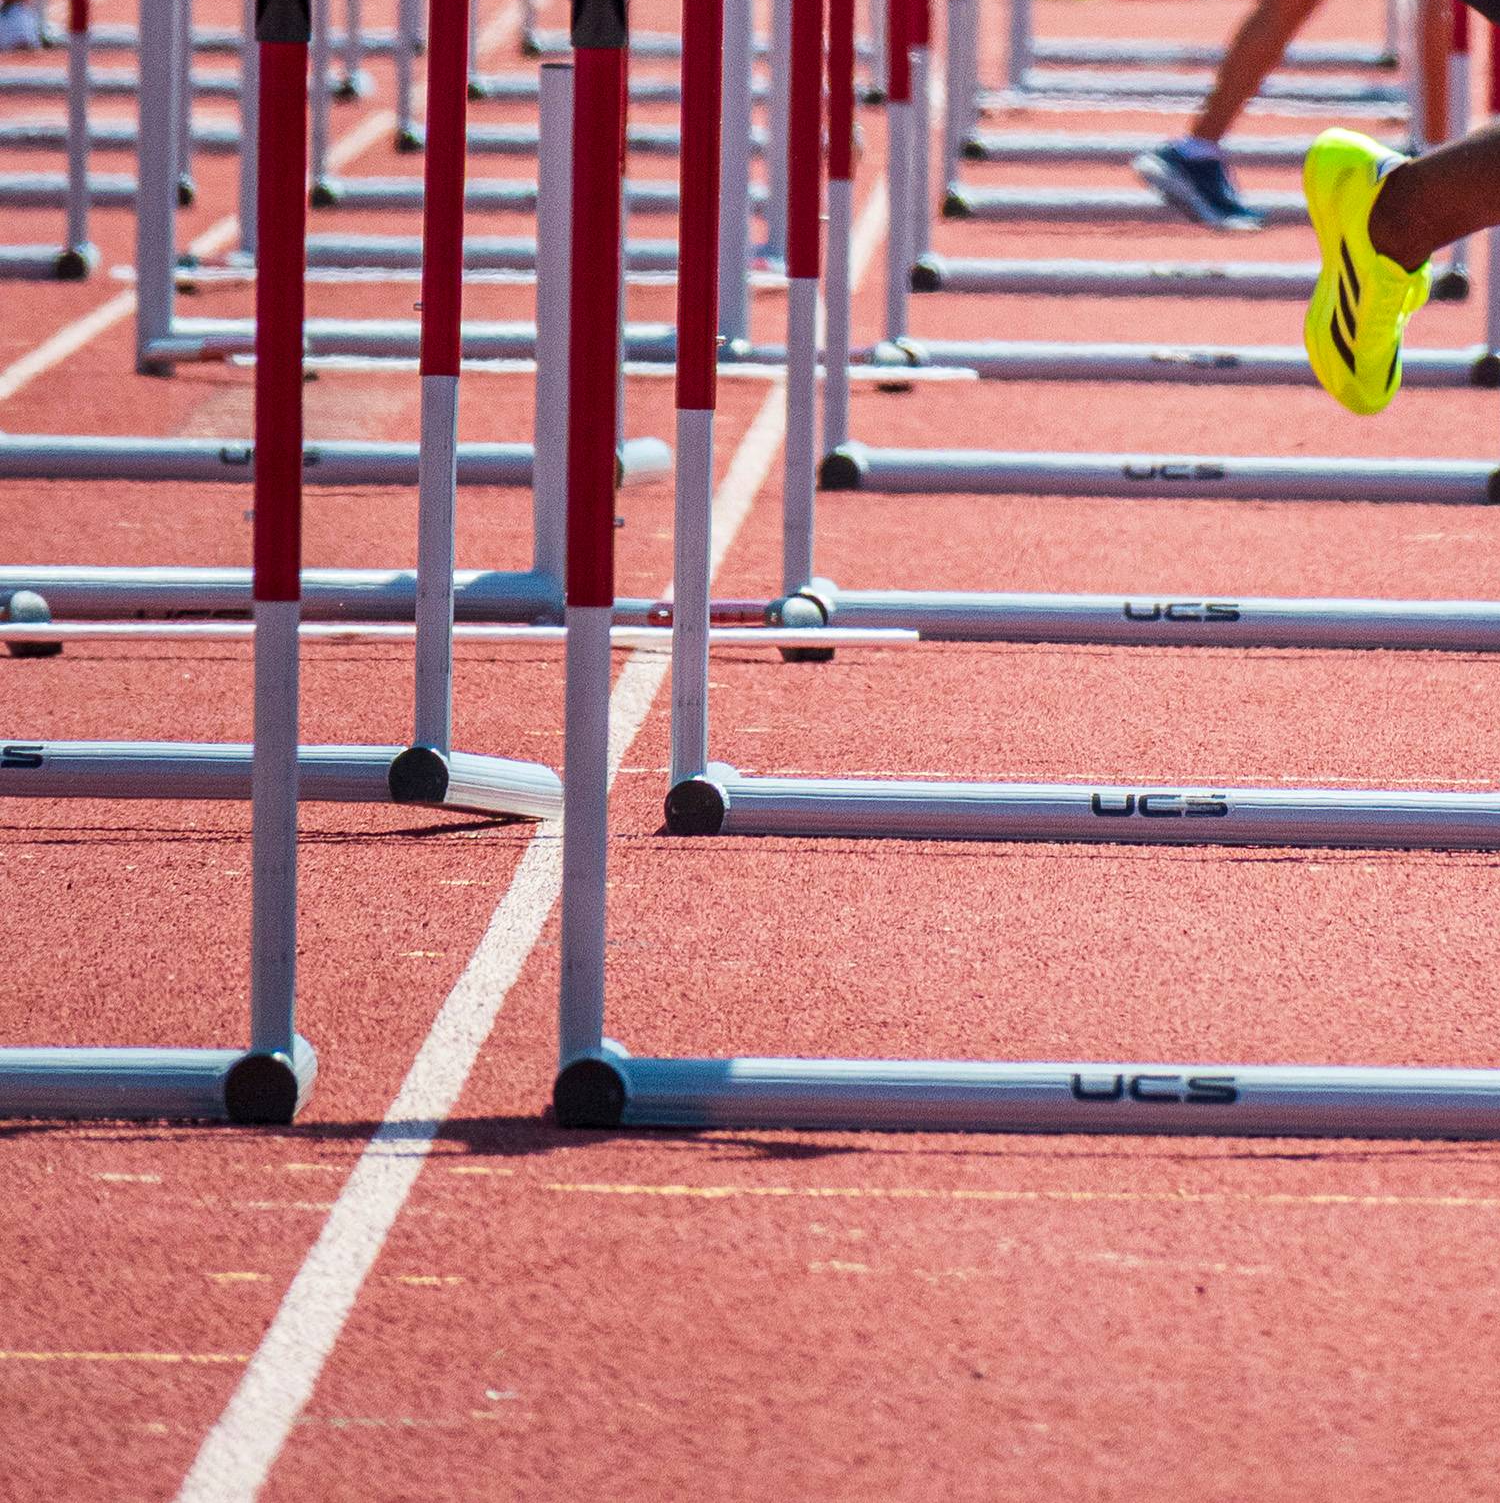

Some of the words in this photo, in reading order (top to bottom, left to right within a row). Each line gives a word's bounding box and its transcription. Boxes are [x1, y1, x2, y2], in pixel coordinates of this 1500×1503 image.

[1124, 602, 1241, 622] UCS
[1091, 791, 1229, 818] UCS
[1070, 1073, 1239, 1104] UCS
